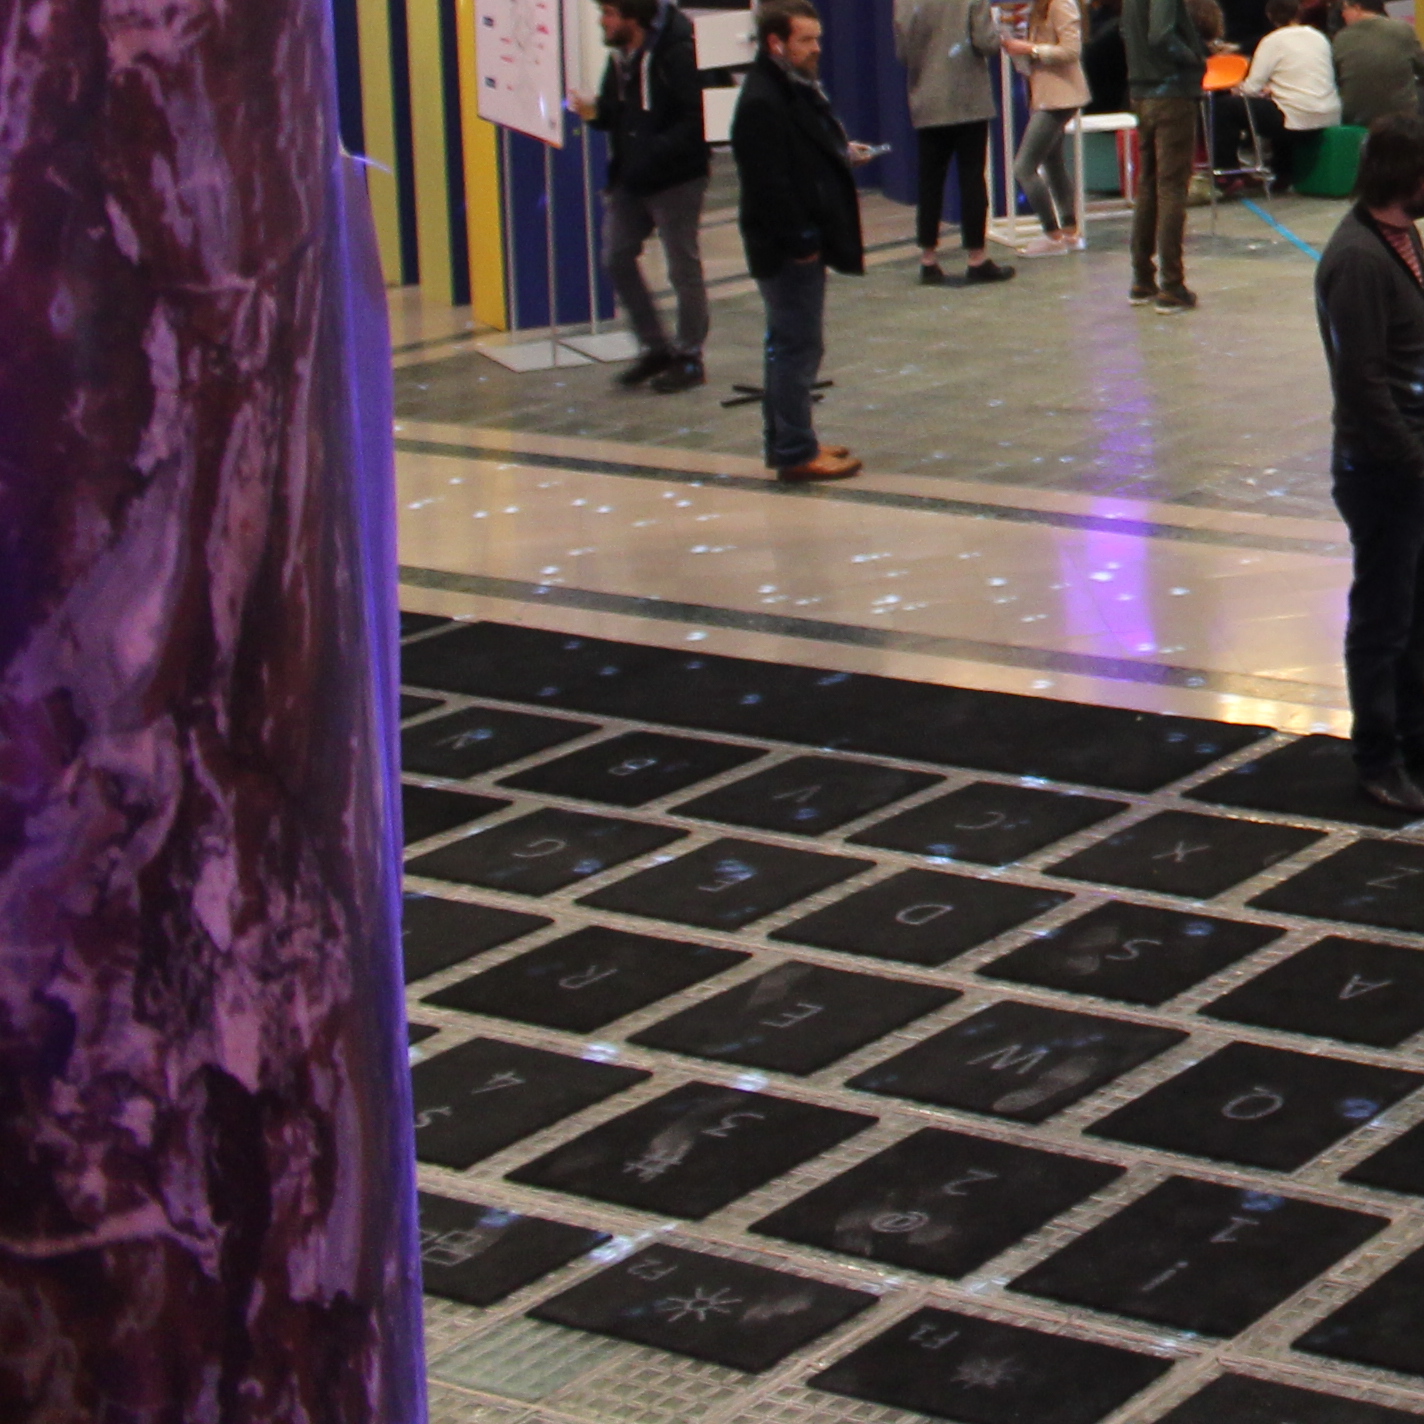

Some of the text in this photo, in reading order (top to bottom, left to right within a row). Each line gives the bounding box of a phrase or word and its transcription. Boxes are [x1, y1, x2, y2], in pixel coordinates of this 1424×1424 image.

[609, 758, 657, 776] B
[772, 785, 820, 803] V
[954, 811, 1006, 830] C
[1153, 841, 1209, 862] X
[1365, 865, 1423, 889] Z
[895, 903, 953, 926] D
[1104, 937, 1162, 961] S
[559, 965, 618, 990] R
[1339, 974, 1391, 1000] A
[759, 1001, 824, 1029] E
[966, 1044, 1048, 1076] W
[473, 1071, 525, 1093] 4
[1221, 1085, 1284, 1119] Q
[701, 1112, 765, 1137] 3
[941, 1168, 999, 1197] 2
[868, 1211, 929, 1232] @
[1210, 1216, 1259, 1243] 1
[627, 1257, 678, 1282] F2
[908, 1322, 961, 1350] F1
